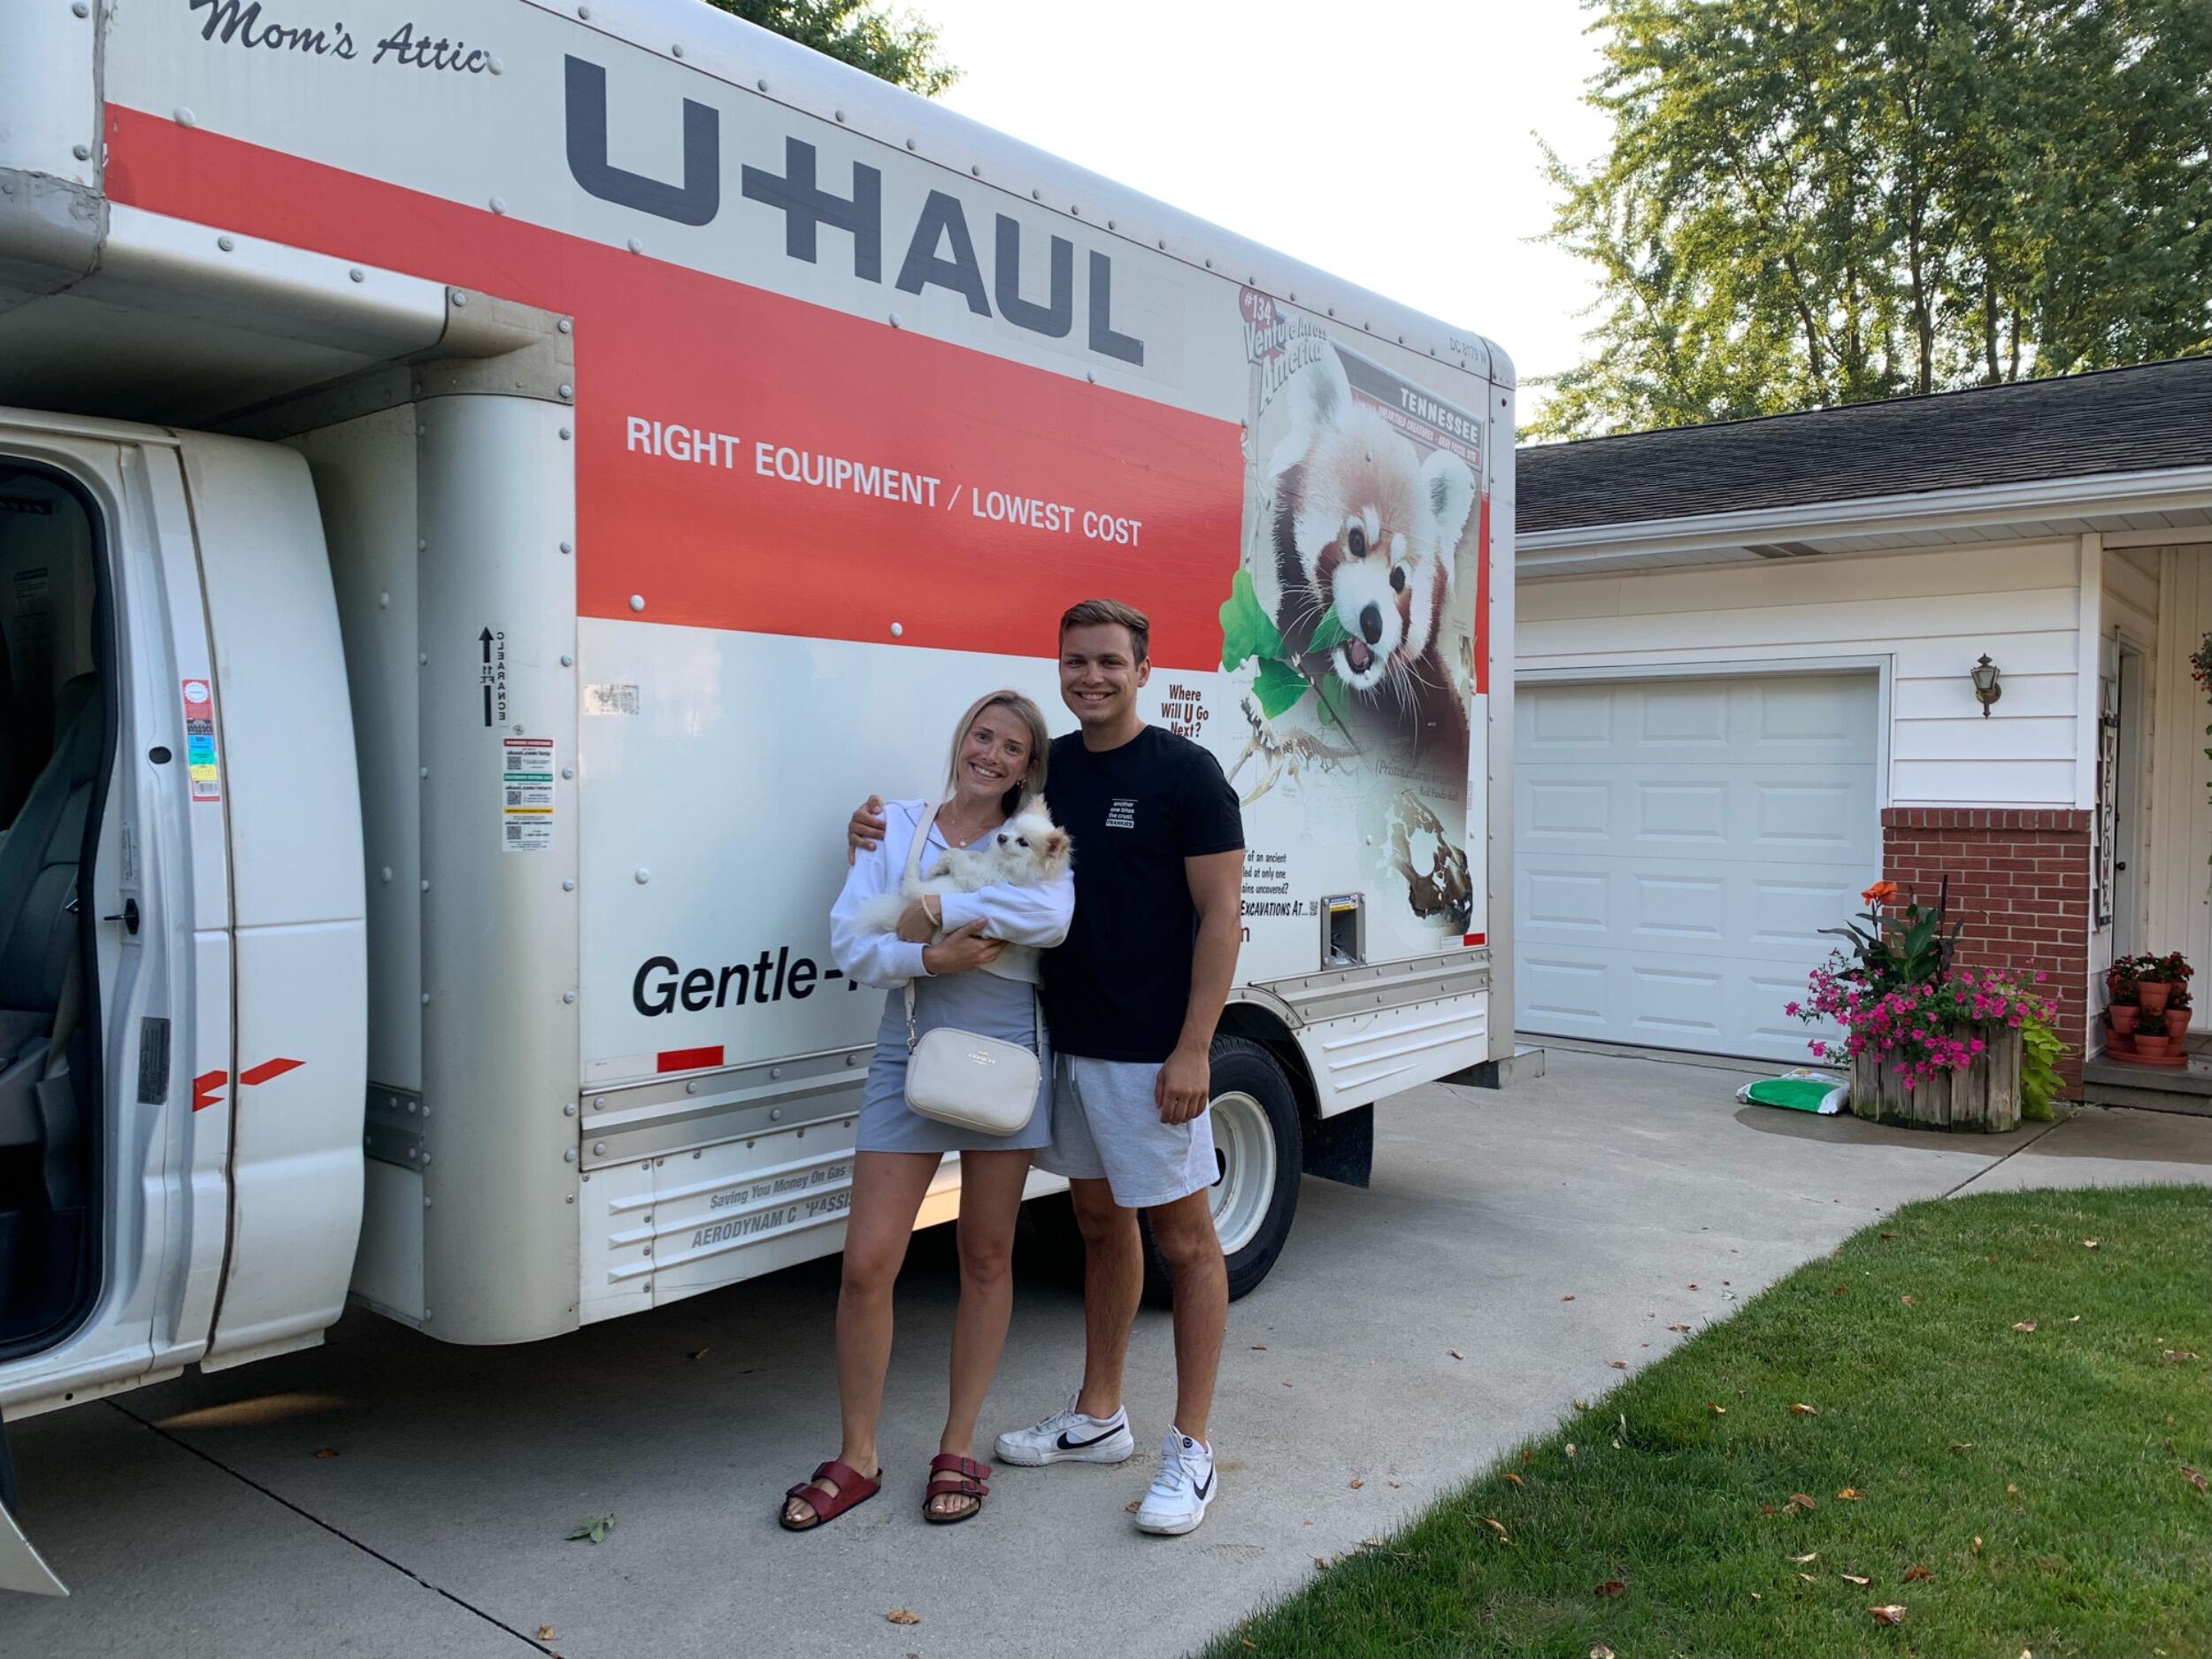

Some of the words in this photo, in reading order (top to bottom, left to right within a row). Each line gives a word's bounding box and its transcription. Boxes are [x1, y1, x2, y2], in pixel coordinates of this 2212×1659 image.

[189, 0, 357, 59] Mom's
[373, 22, 487, 73] Attic
[1244, 292, 1271, 325] #134
[1244, 318, 1296, 364] Venture
[1449, 337, 1462, 353] DC
[1259, 342, 1323, 418] America
[1401, 388, 1479, 443] TENNESSEE
[626, 416, 740, 468] RIGHT
[756, 442, 941, 508] EQUIPMENT
[972, 488, 1074, 533] LOWEST
[1083, 511, 1143, 546] COST
[1170, 684, 1202, 702] Where
[1161, 703, 1181, 718] Will
[1184, 703, 1194, 724] U
[1196, 705, 1209, 720] Go
[1170, 721, 1202, 738] Next?
[1248, 849, 1255, 862] of
[1256, 853, 1263, 863] an
[1265, 851, 1286, 864] ancient
[1254, 867, 1260, 878] at
[1262, 867, 1274, 881] only
[1241, 883, 1254, 894] ains
[1256, 882, 1289, 895] uncovered?
[633, 946, 848, 1017] Gentle-
[710, 1190, 749, 1210] Saving
[752, 1184, 771, 1198] You
[773, 1174, 809, 1194] Money
[811, 1170, 825, 1184] On
[827, 1165, 846, 1179] Gas
[691, 1207, 797, 1248] AERODYNAMC
